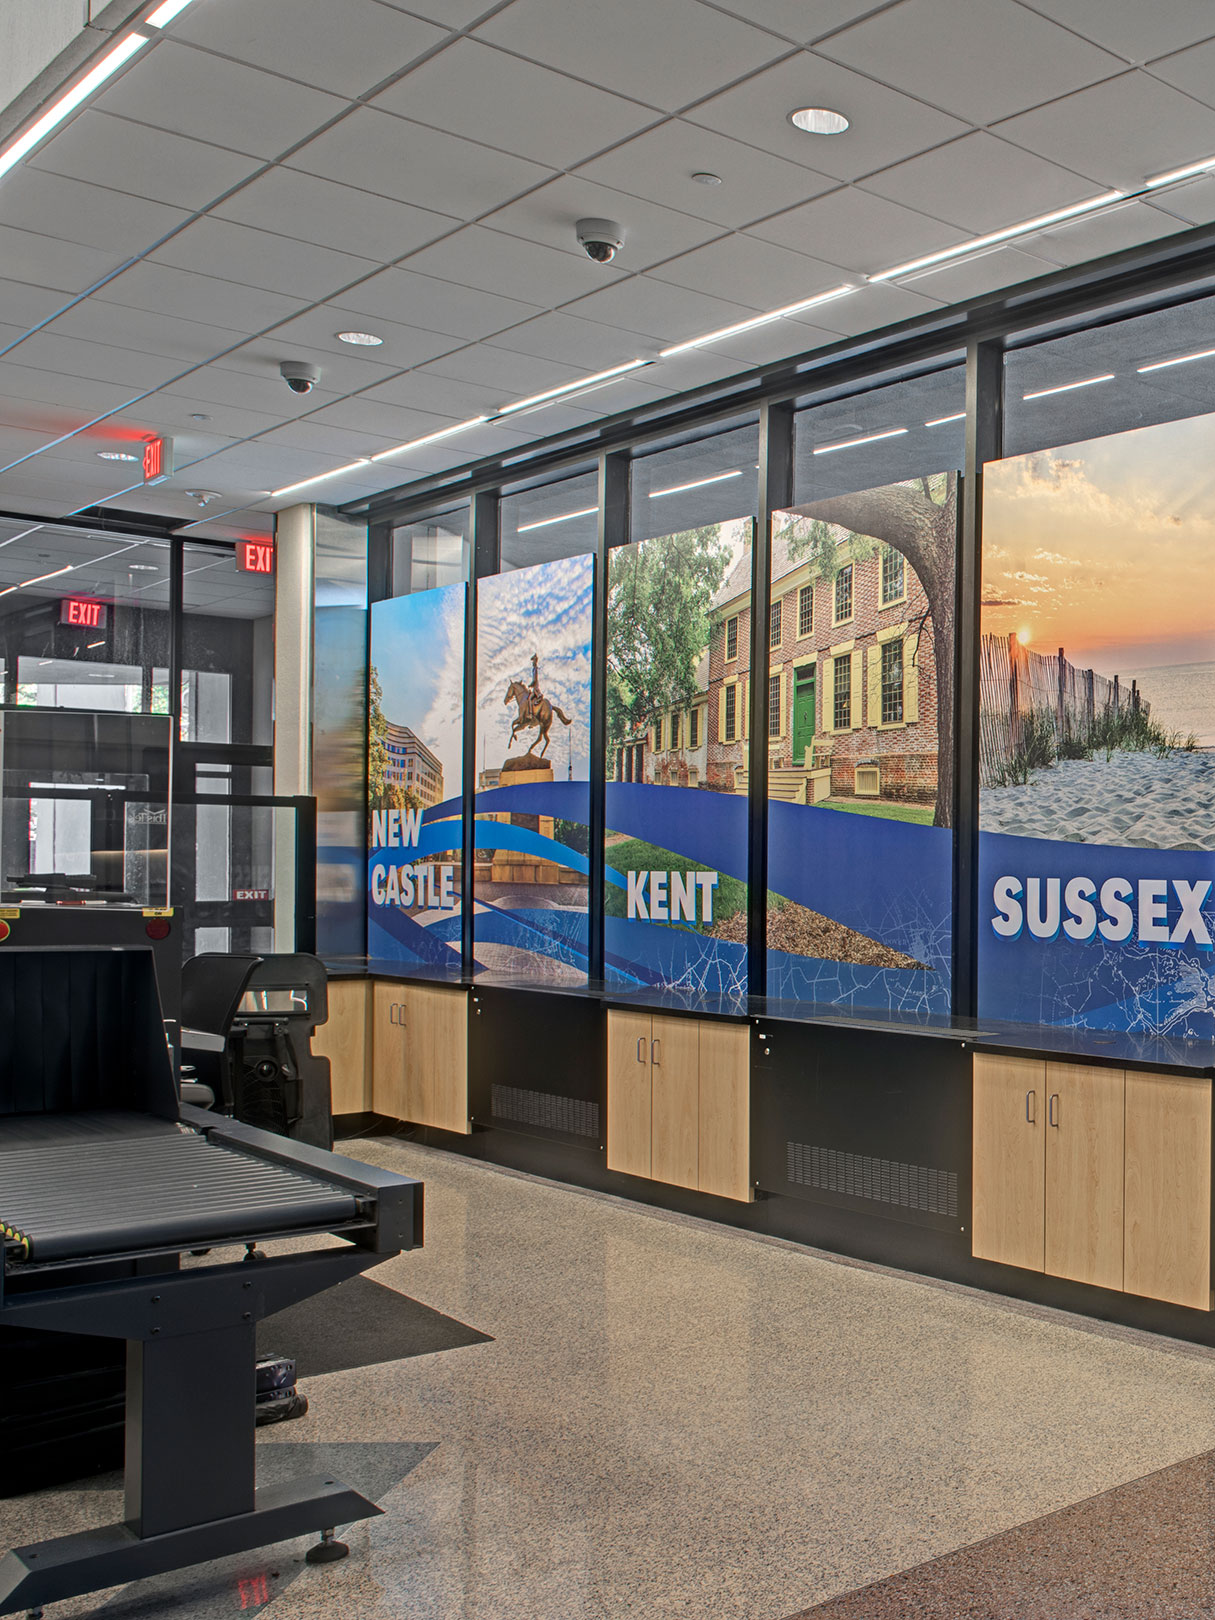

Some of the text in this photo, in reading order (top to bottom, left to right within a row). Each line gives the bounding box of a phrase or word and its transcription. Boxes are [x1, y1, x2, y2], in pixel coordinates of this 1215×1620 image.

[245, 543, 274, 573] EXI
[69, 600, 102, 626] EXIT
[372, 808, 423, 849] NEW
[236, 890, 267, 900] EXIT
[372, 863, 454, 909] CASTLE
[627, 870, 718, 924] KENT
[991, 876, 1213, 949] SUSSEX
